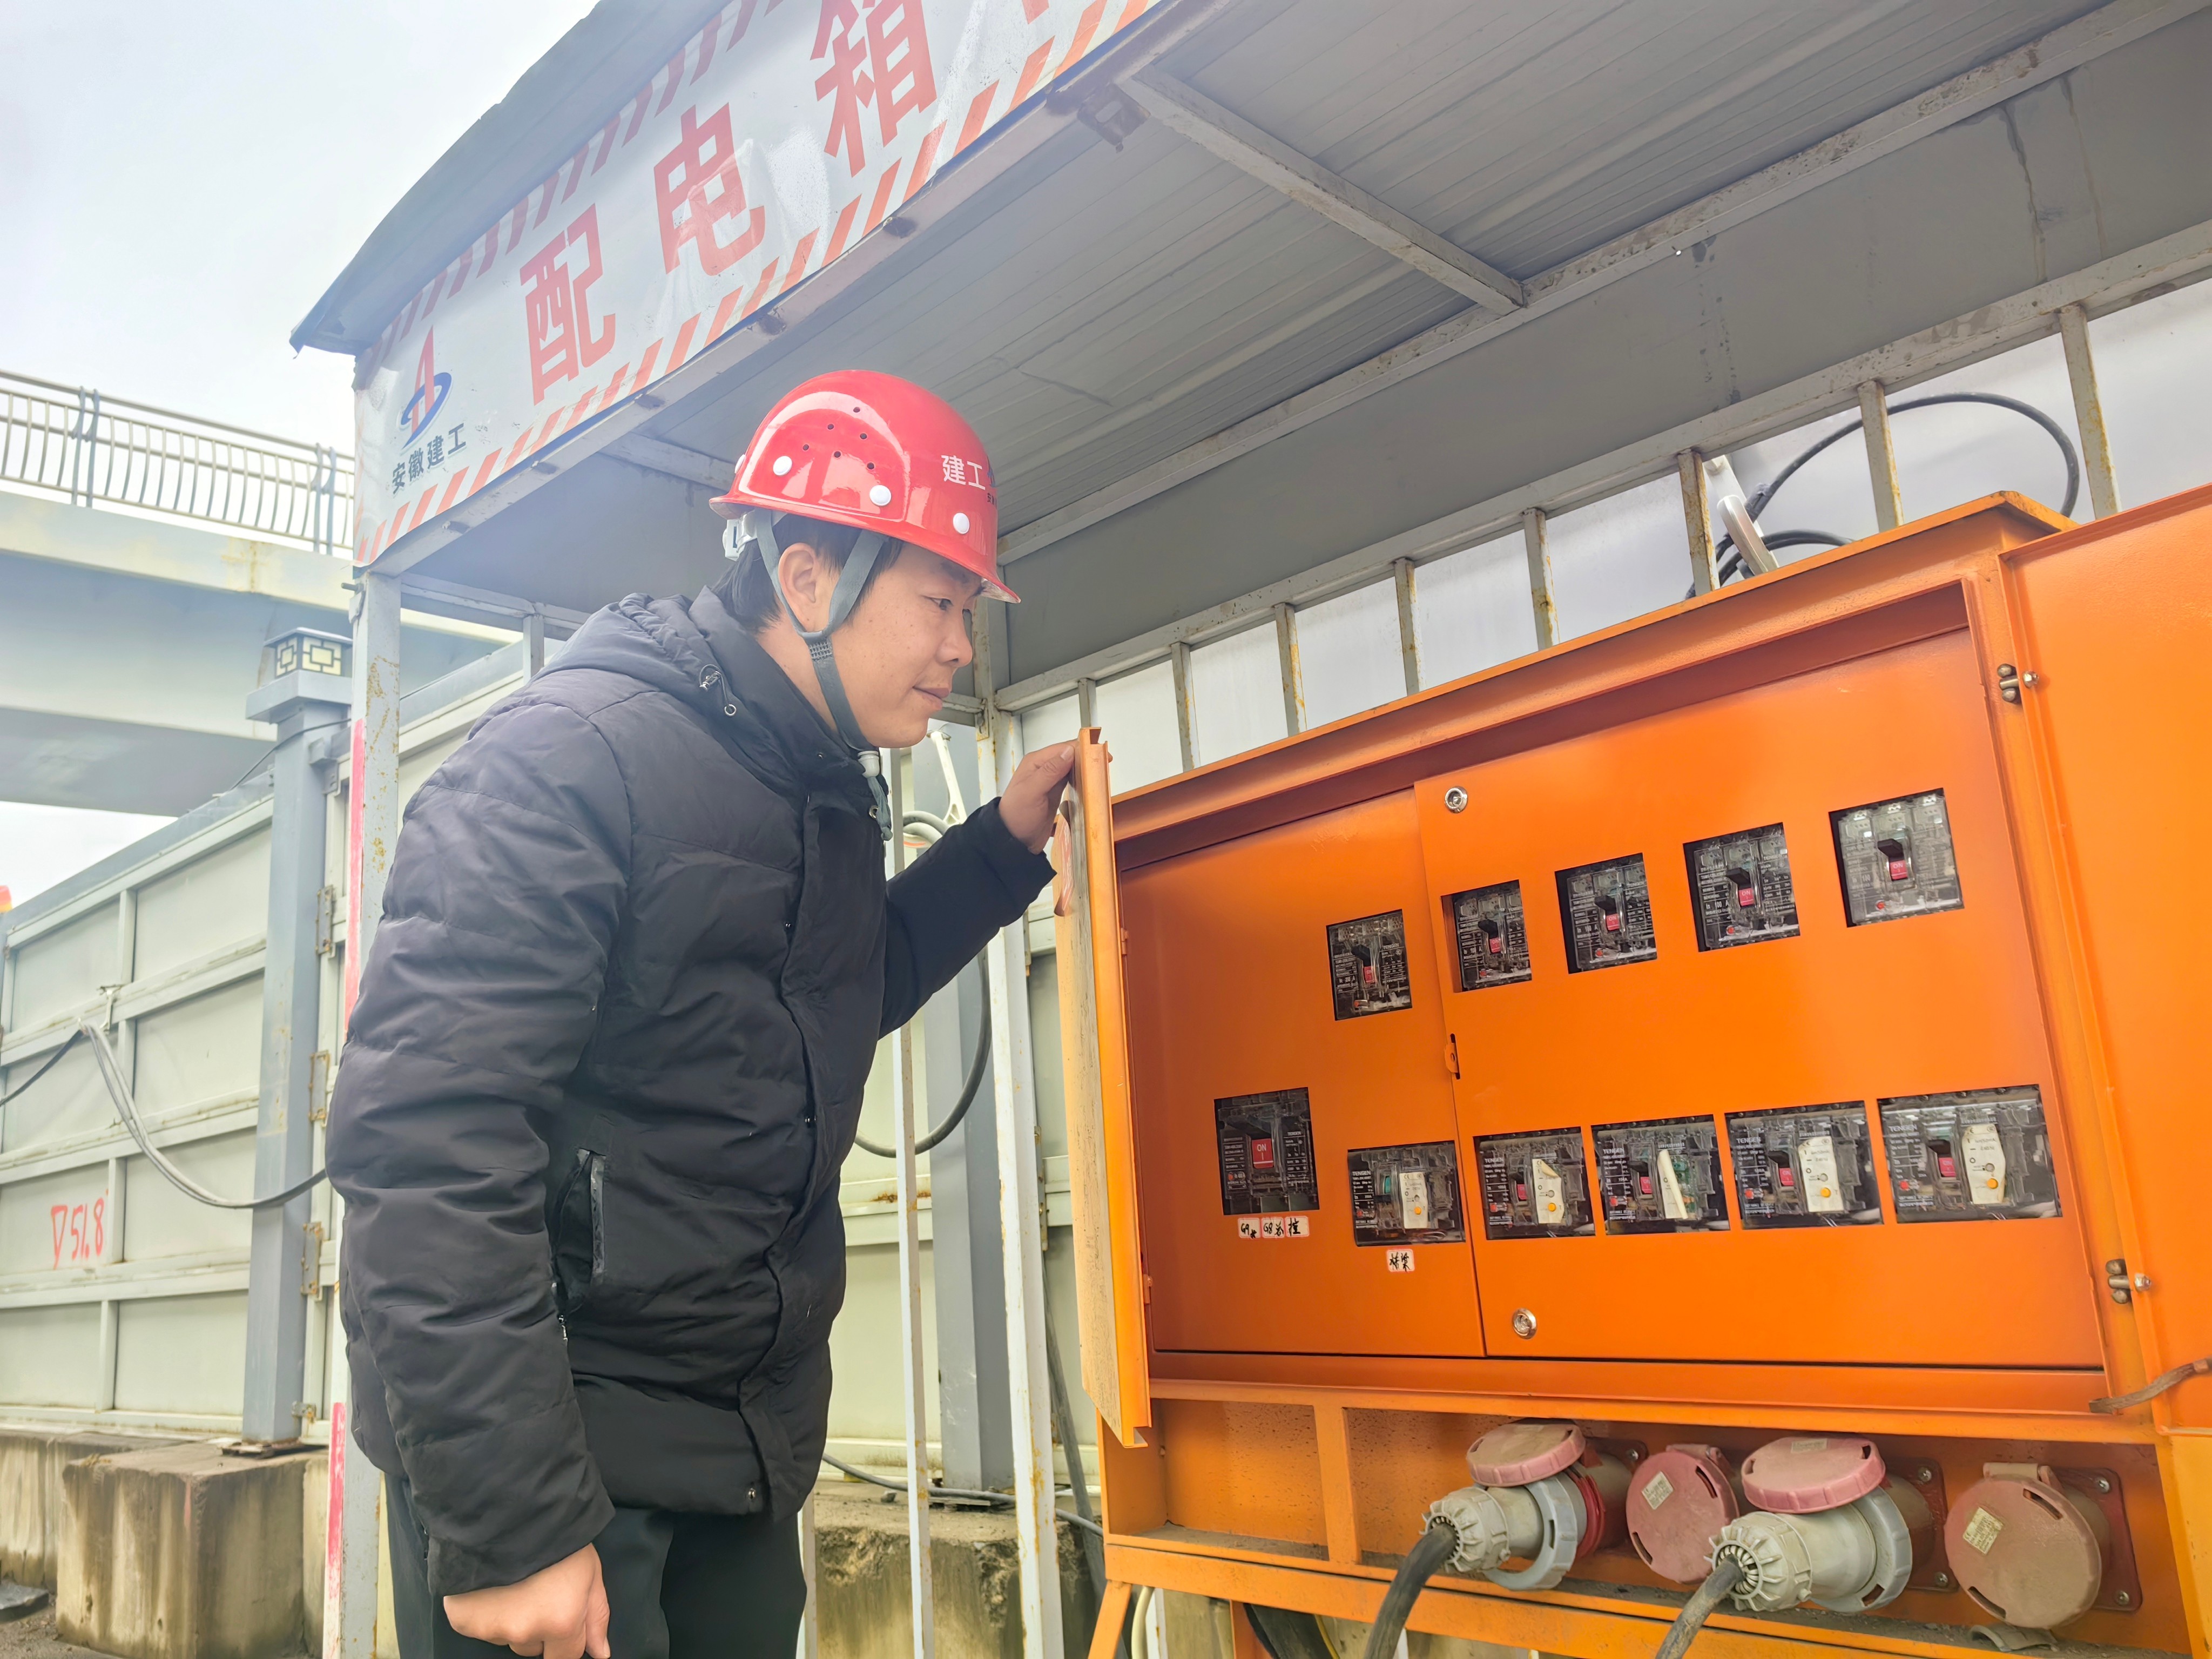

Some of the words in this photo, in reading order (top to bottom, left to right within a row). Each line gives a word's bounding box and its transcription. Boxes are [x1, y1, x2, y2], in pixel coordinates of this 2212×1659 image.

[520, 0, 1050, 406] 配电箱
[392, 422, 467, 495] 安徽建工
[941, 455, 986, 490] 建工
[1257, 1144, 1267, 1152] ON
